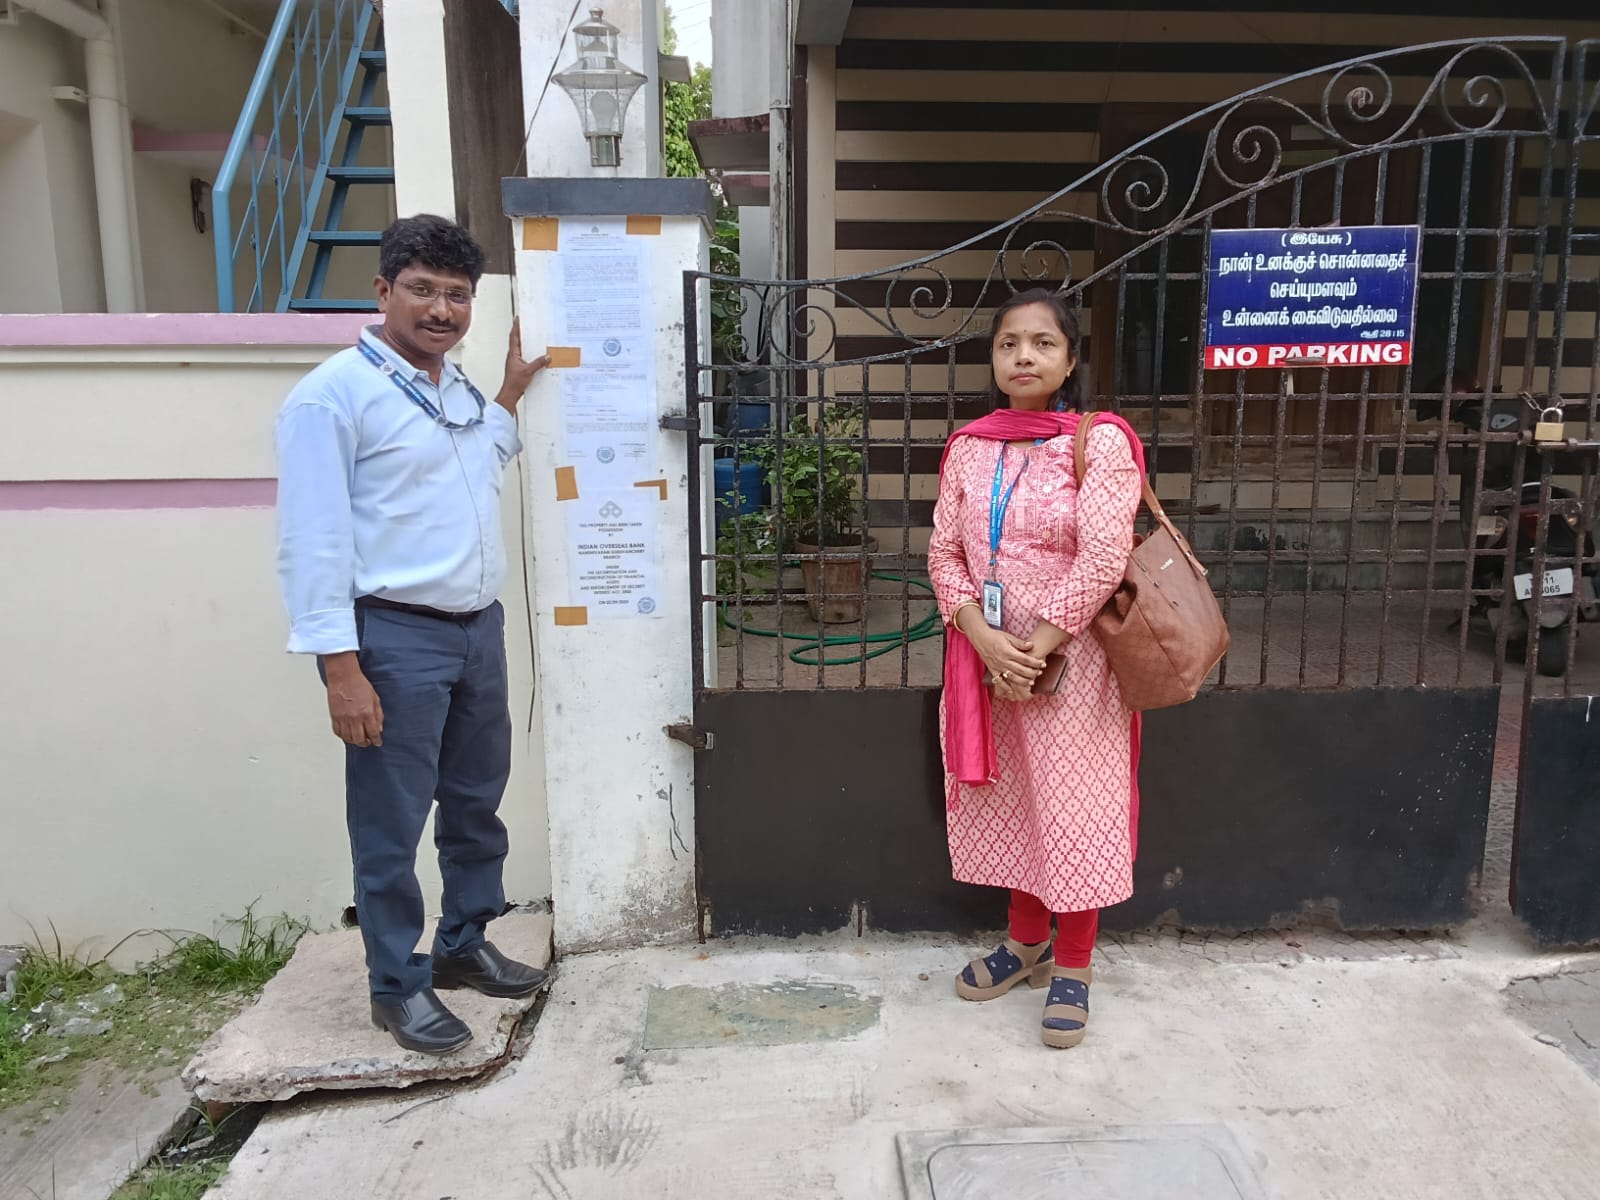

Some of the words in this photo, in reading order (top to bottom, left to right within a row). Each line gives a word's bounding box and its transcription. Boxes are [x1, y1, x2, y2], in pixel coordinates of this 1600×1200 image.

[1219, 252, 1253, 277] நான்
[1256, 252, 1317, 273] உனக்குச்
[1319, 249, 1407, 272] சொன்னதைச்
[1270, 277, 1357, 302] செய்யுமளவும்
[1222, 307, 1289, 327] உன்னைக்
[1292, 305, 1397, 328] கைவிடுவதில்லை
[1214, 347, 1258, 367] NO
[1268, 344, 1403, 365] PARKING
